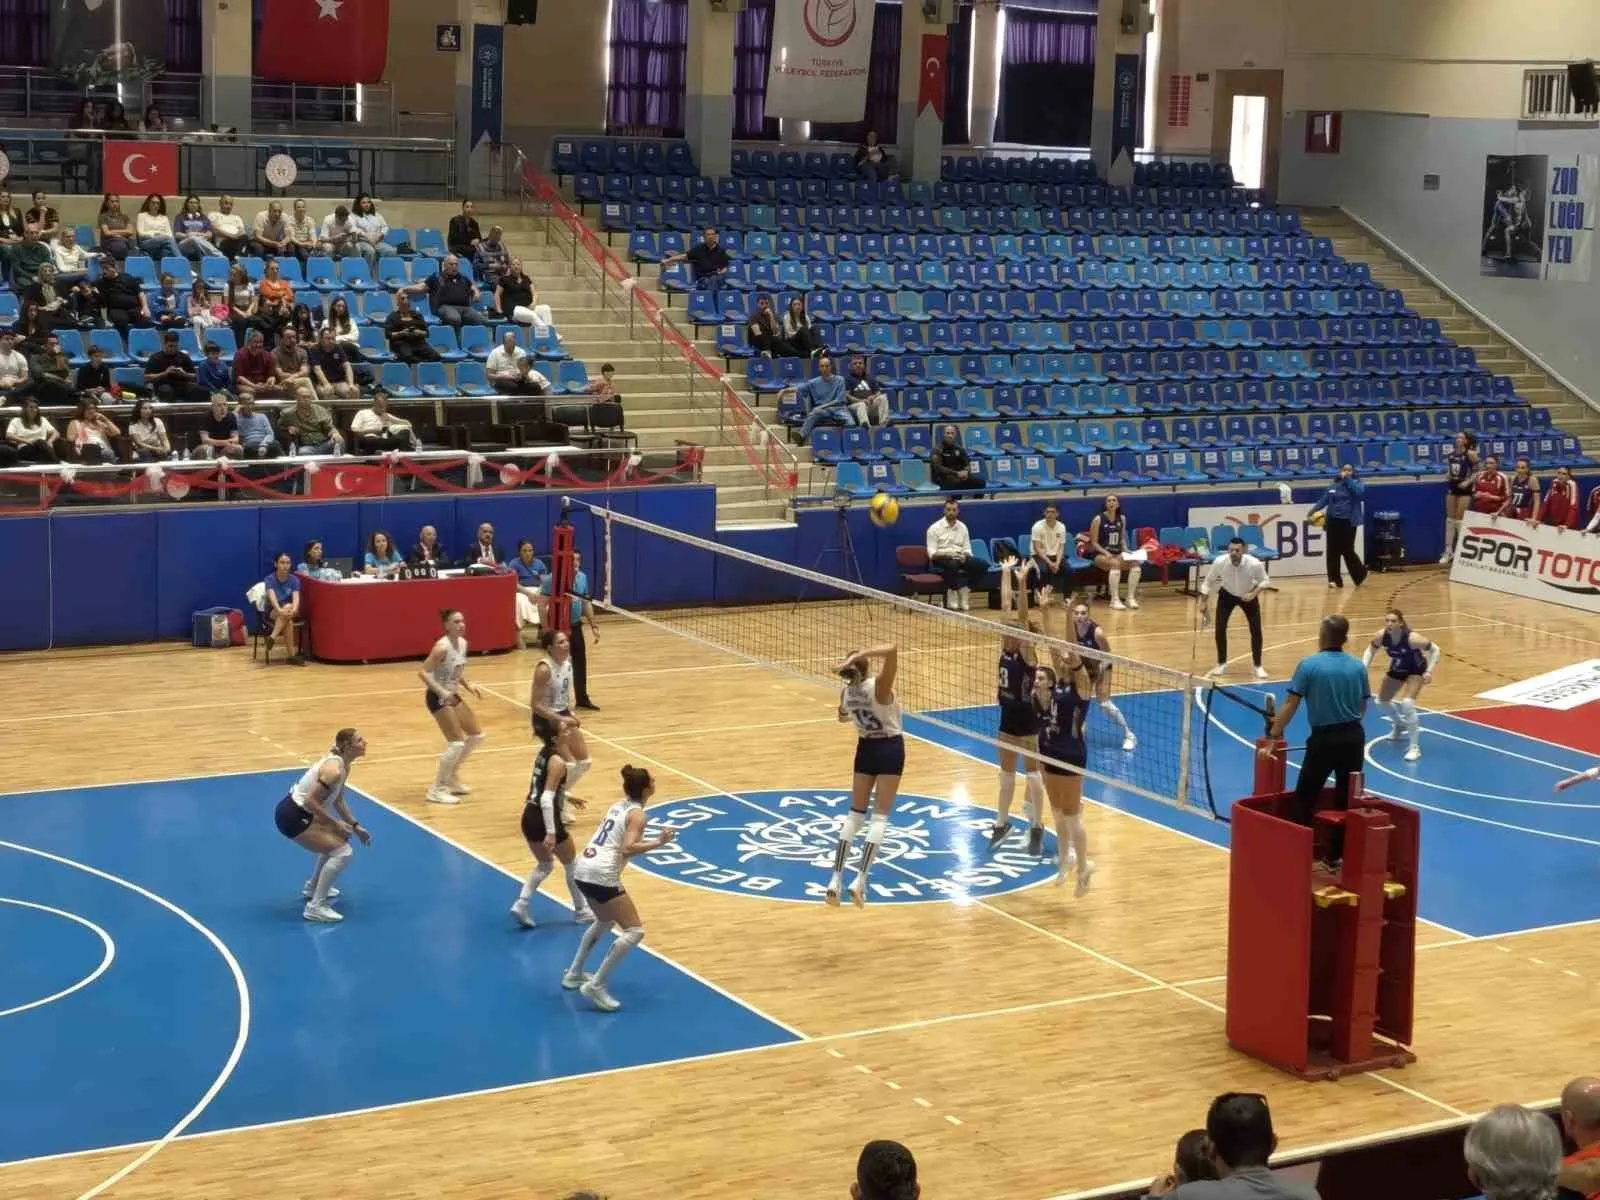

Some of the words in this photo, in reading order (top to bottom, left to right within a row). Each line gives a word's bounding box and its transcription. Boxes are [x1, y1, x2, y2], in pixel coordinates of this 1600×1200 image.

[1108, 532, 1120, 546] 10
[1460, 535, 1533, 572] SPOR
[779, 795, 968, 818] AYIN
